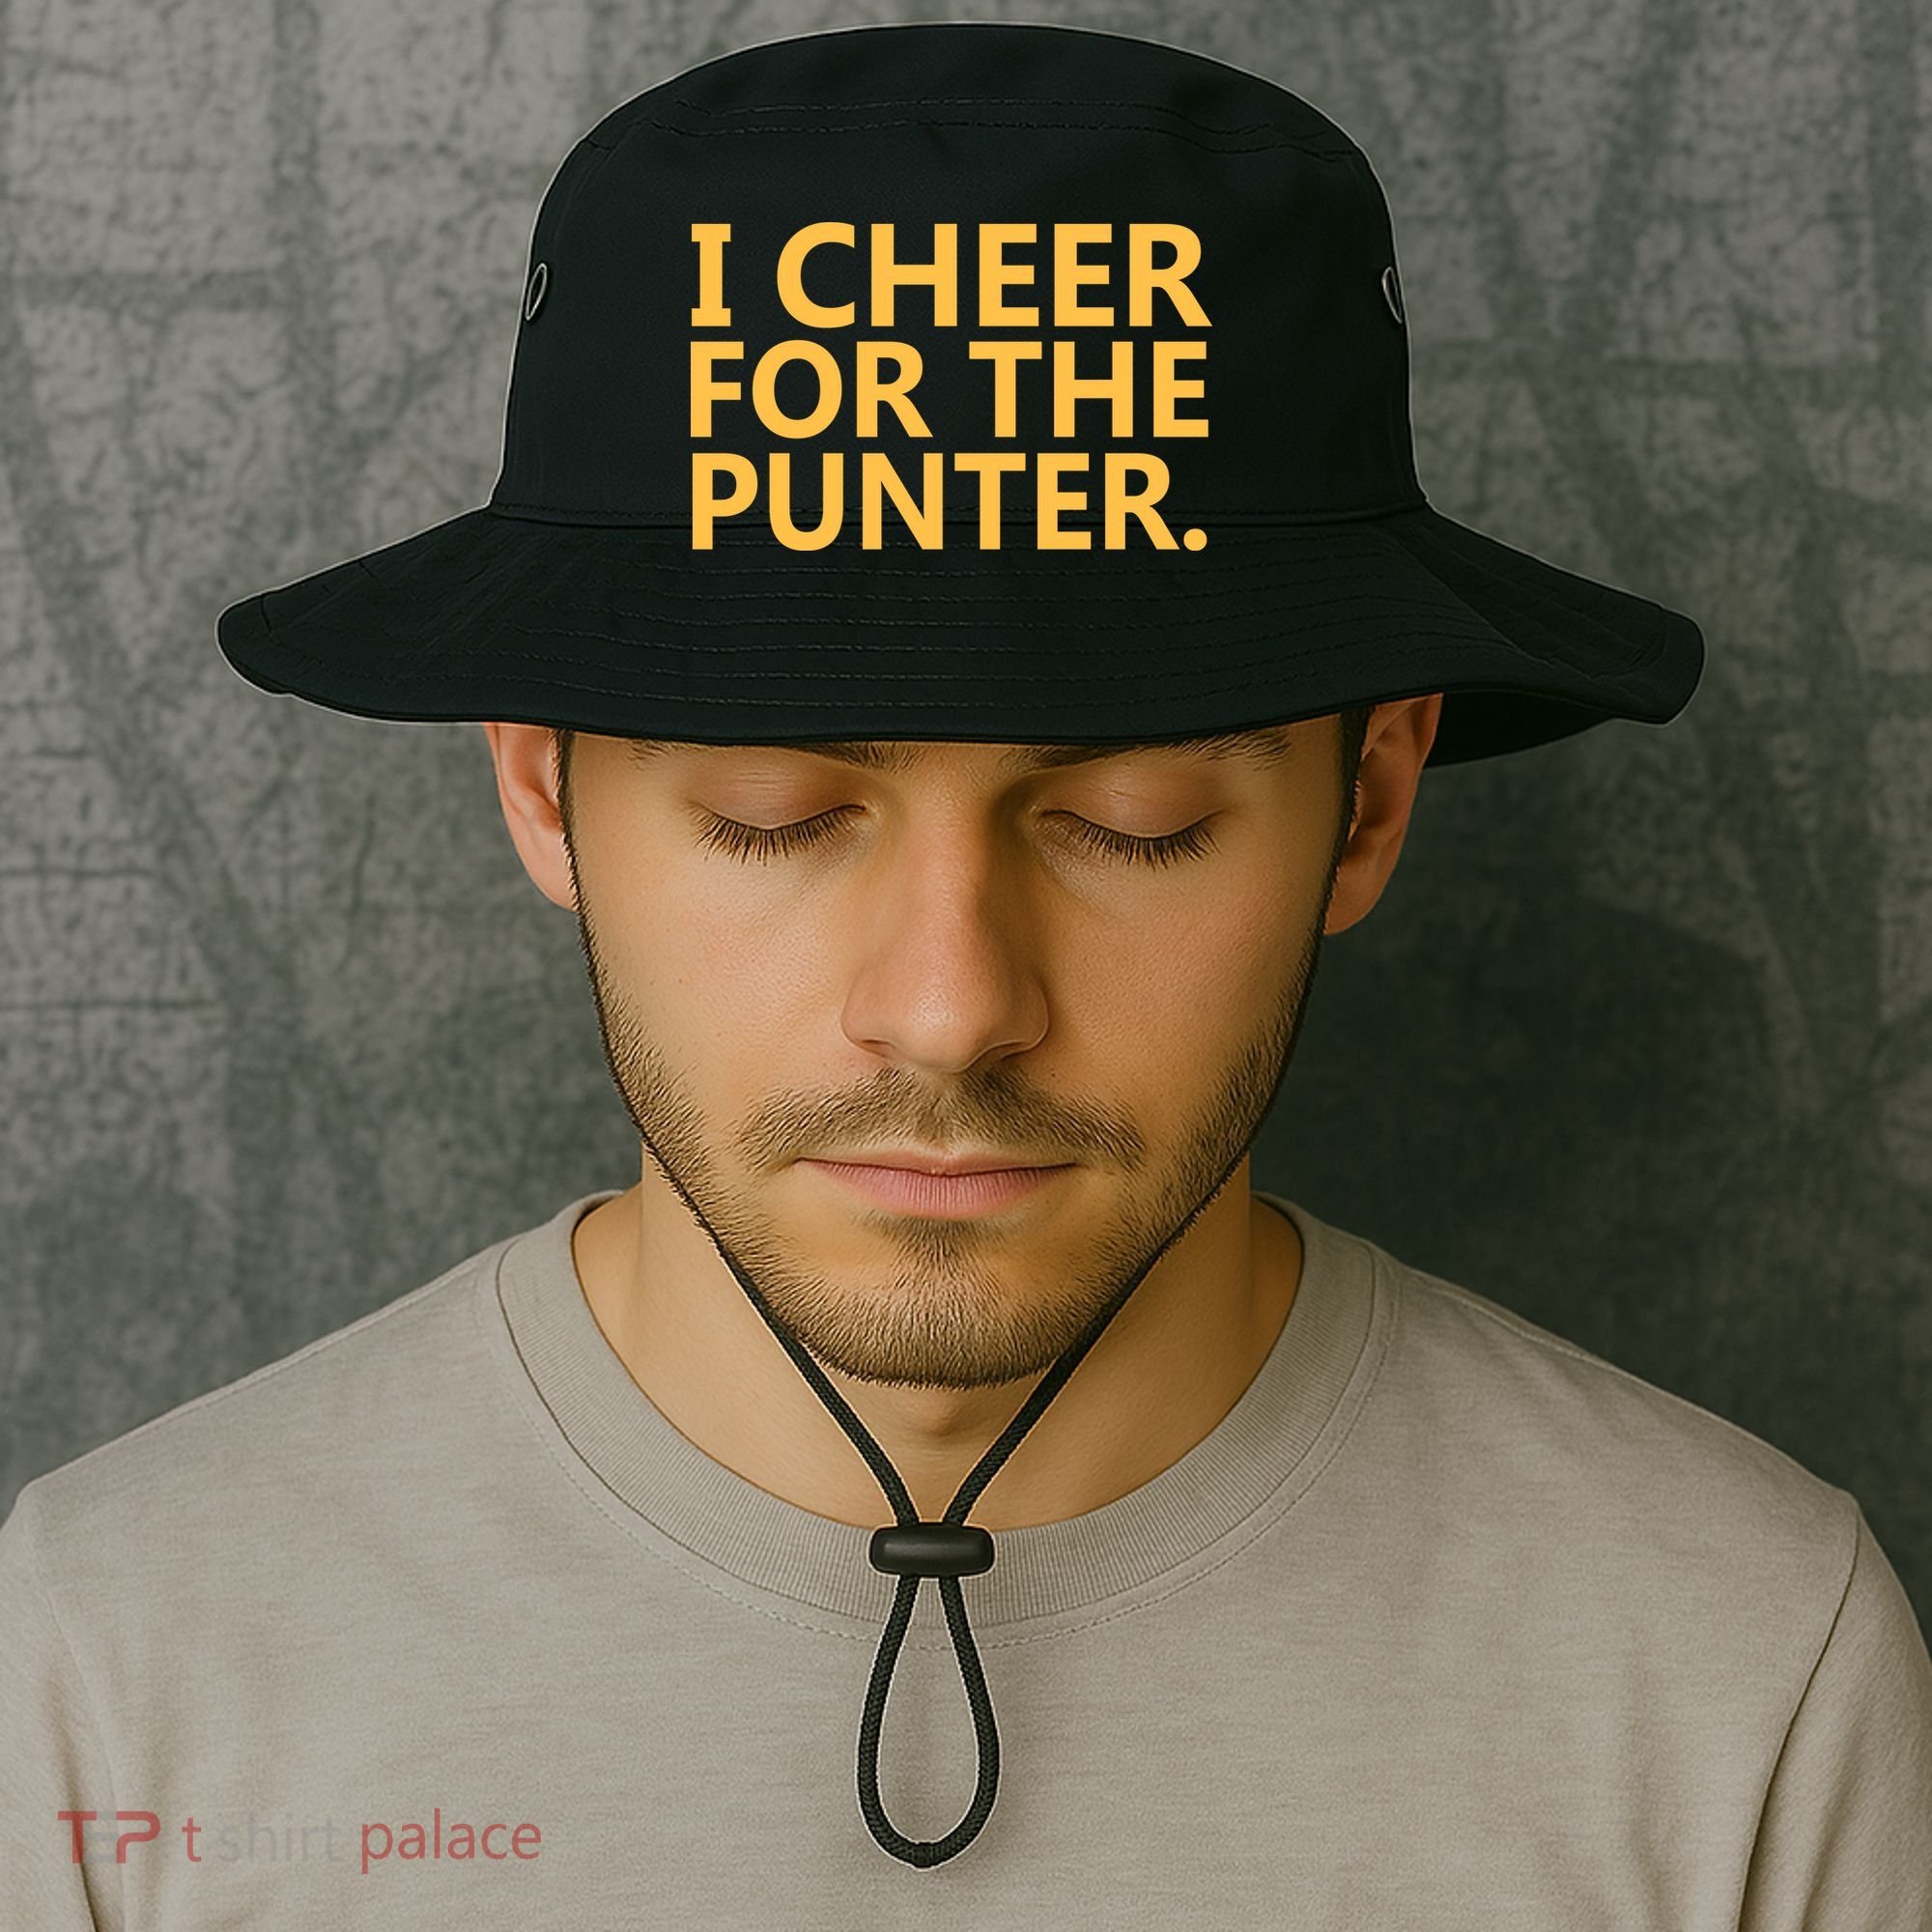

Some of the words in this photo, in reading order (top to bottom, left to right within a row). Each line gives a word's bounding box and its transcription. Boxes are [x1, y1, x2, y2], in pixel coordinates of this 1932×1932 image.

[691, 223, 731, 327] I
[777, 222, 1212, 328] CHEER
[691, 340, 932, 440] FOR
[969, 341, 1209, 438] THE
[692, 453, 1208, 552] PUNTER.
